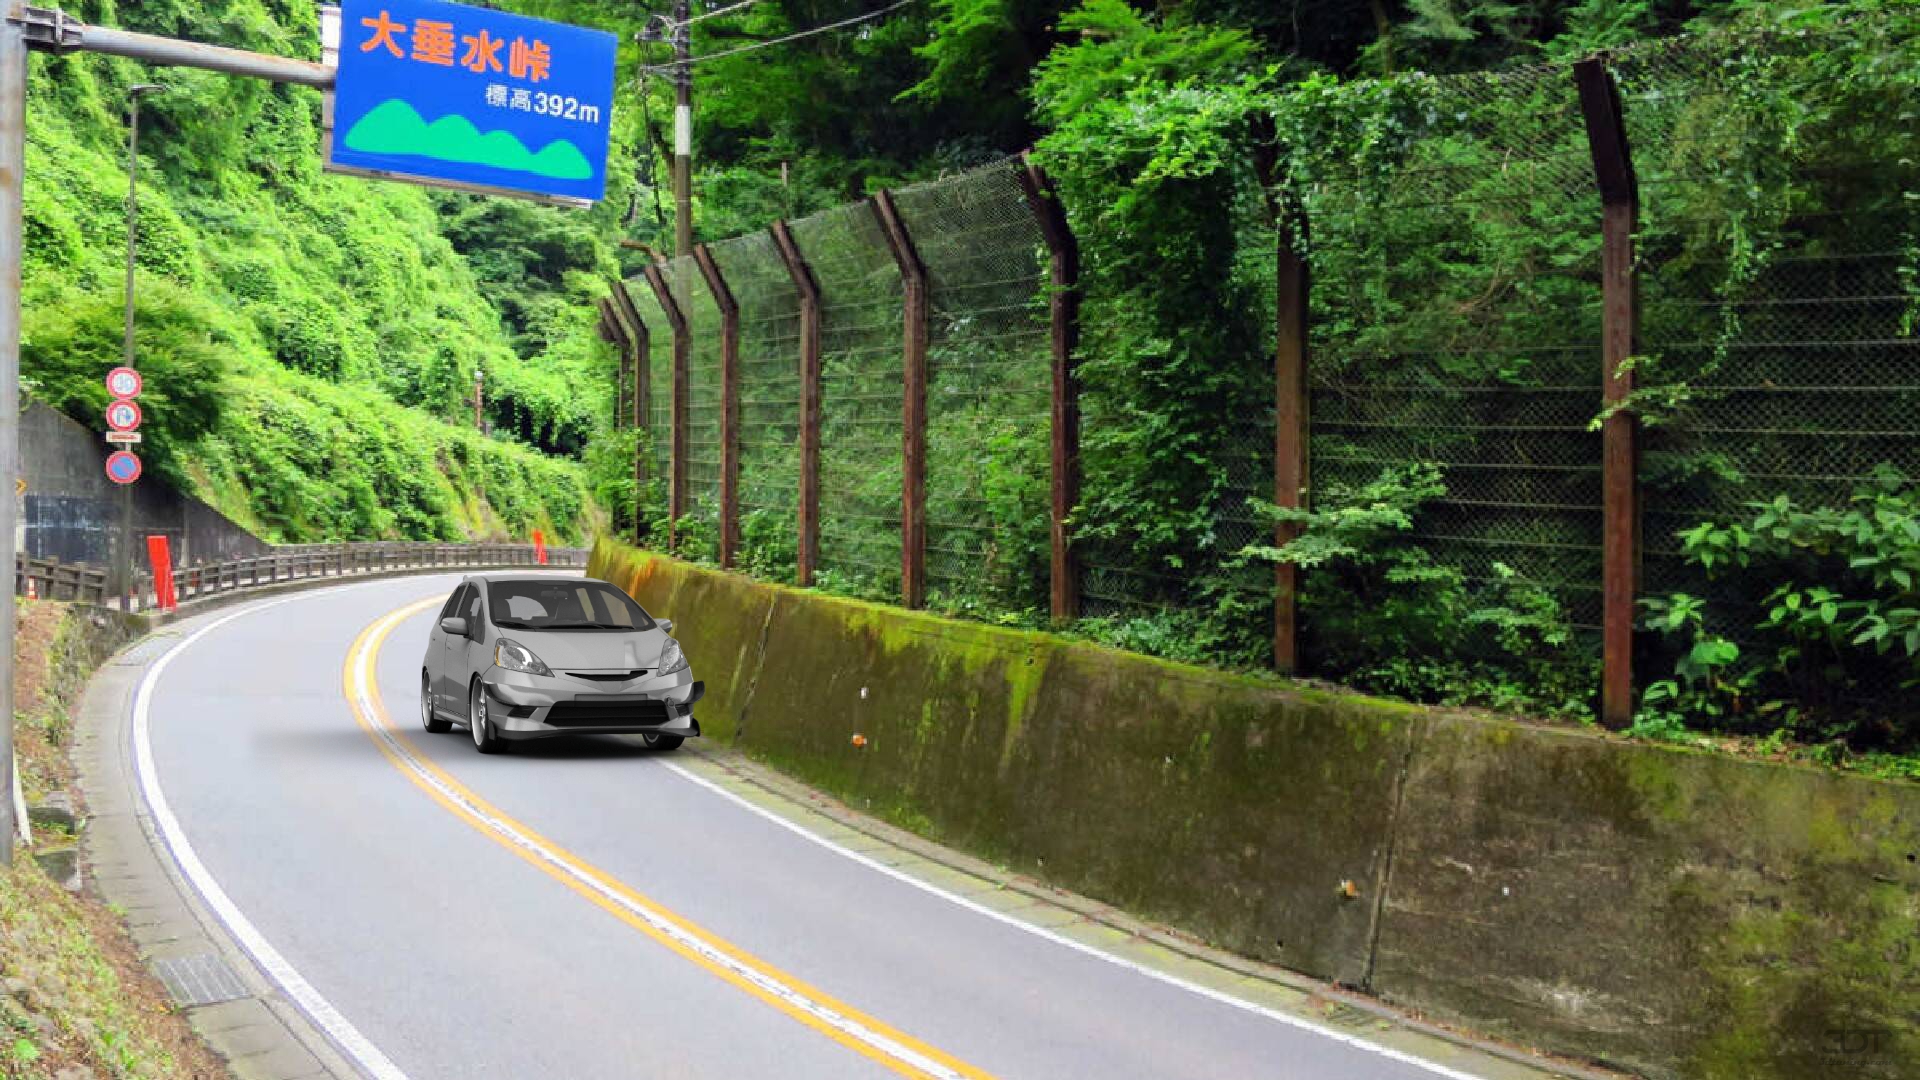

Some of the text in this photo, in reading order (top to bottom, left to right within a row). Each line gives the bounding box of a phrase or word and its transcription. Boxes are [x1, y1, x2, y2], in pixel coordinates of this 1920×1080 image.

[361, 10, 551, 81] 大垂水峠
[486, 83, 600, 123] 標高392m
